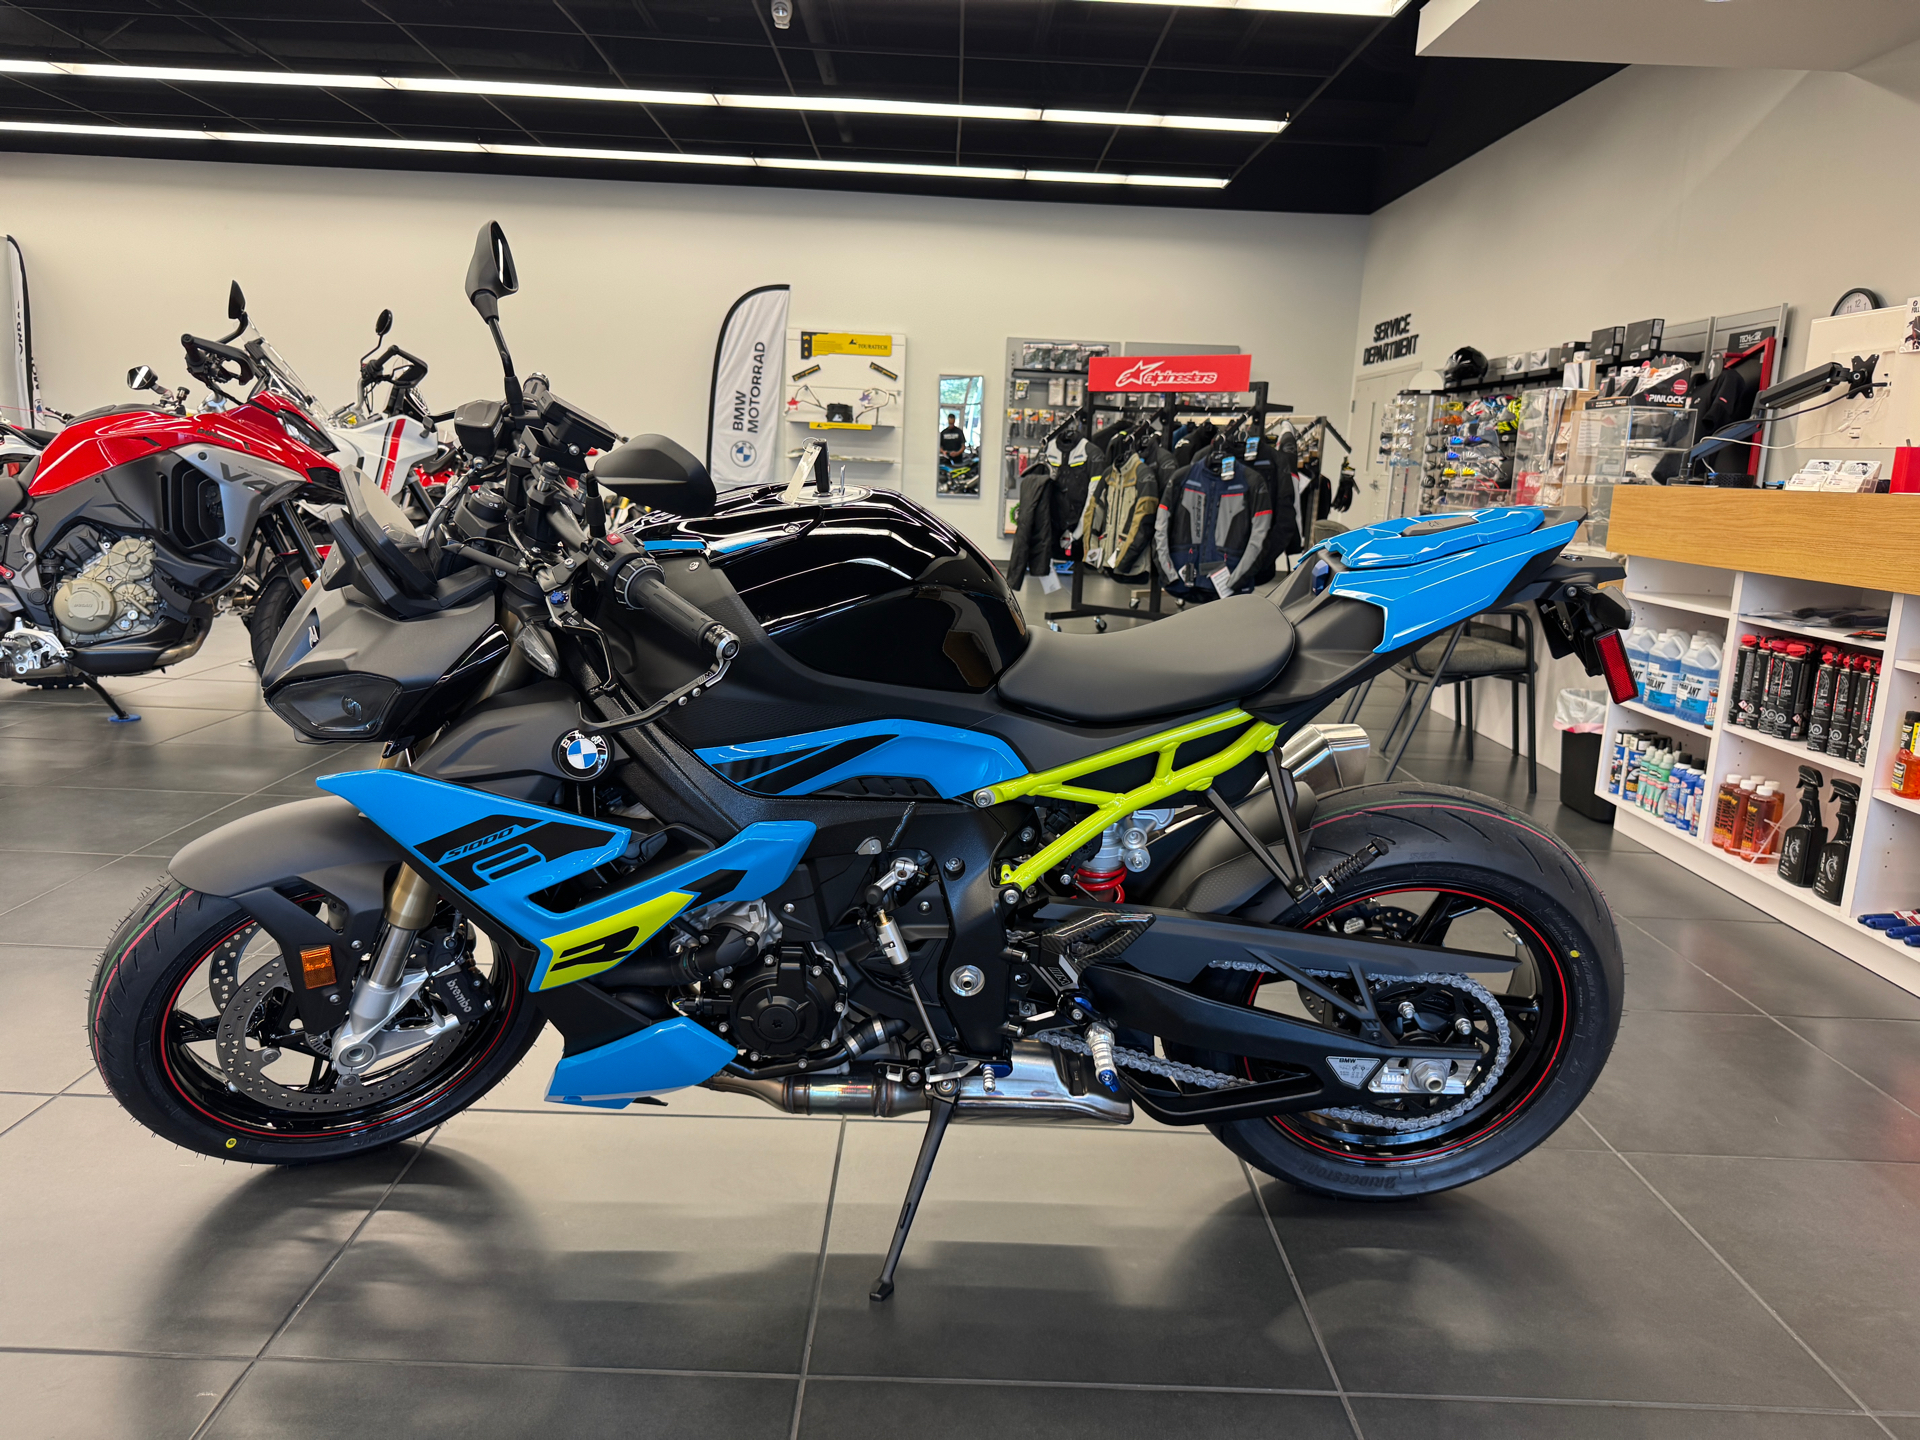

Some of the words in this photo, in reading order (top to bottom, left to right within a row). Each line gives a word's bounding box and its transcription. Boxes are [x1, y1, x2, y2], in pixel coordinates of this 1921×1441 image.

[1373, 313, 1412, 343] SERVICE
[858, 343, 888, 351] TOURATECH
[1362, 334, 1419, 366] DEPARTMENT
[747, 341, 766, 434] MOTORRAD
[1143, 370, 1218, 387] alpinestars
[732, 391, 747, 432] BMW
[1648, 394, 1686, 404] PINLOCK
[446, 826, 514, 860] S1000
[446, 978, 473, 1013] brembo
